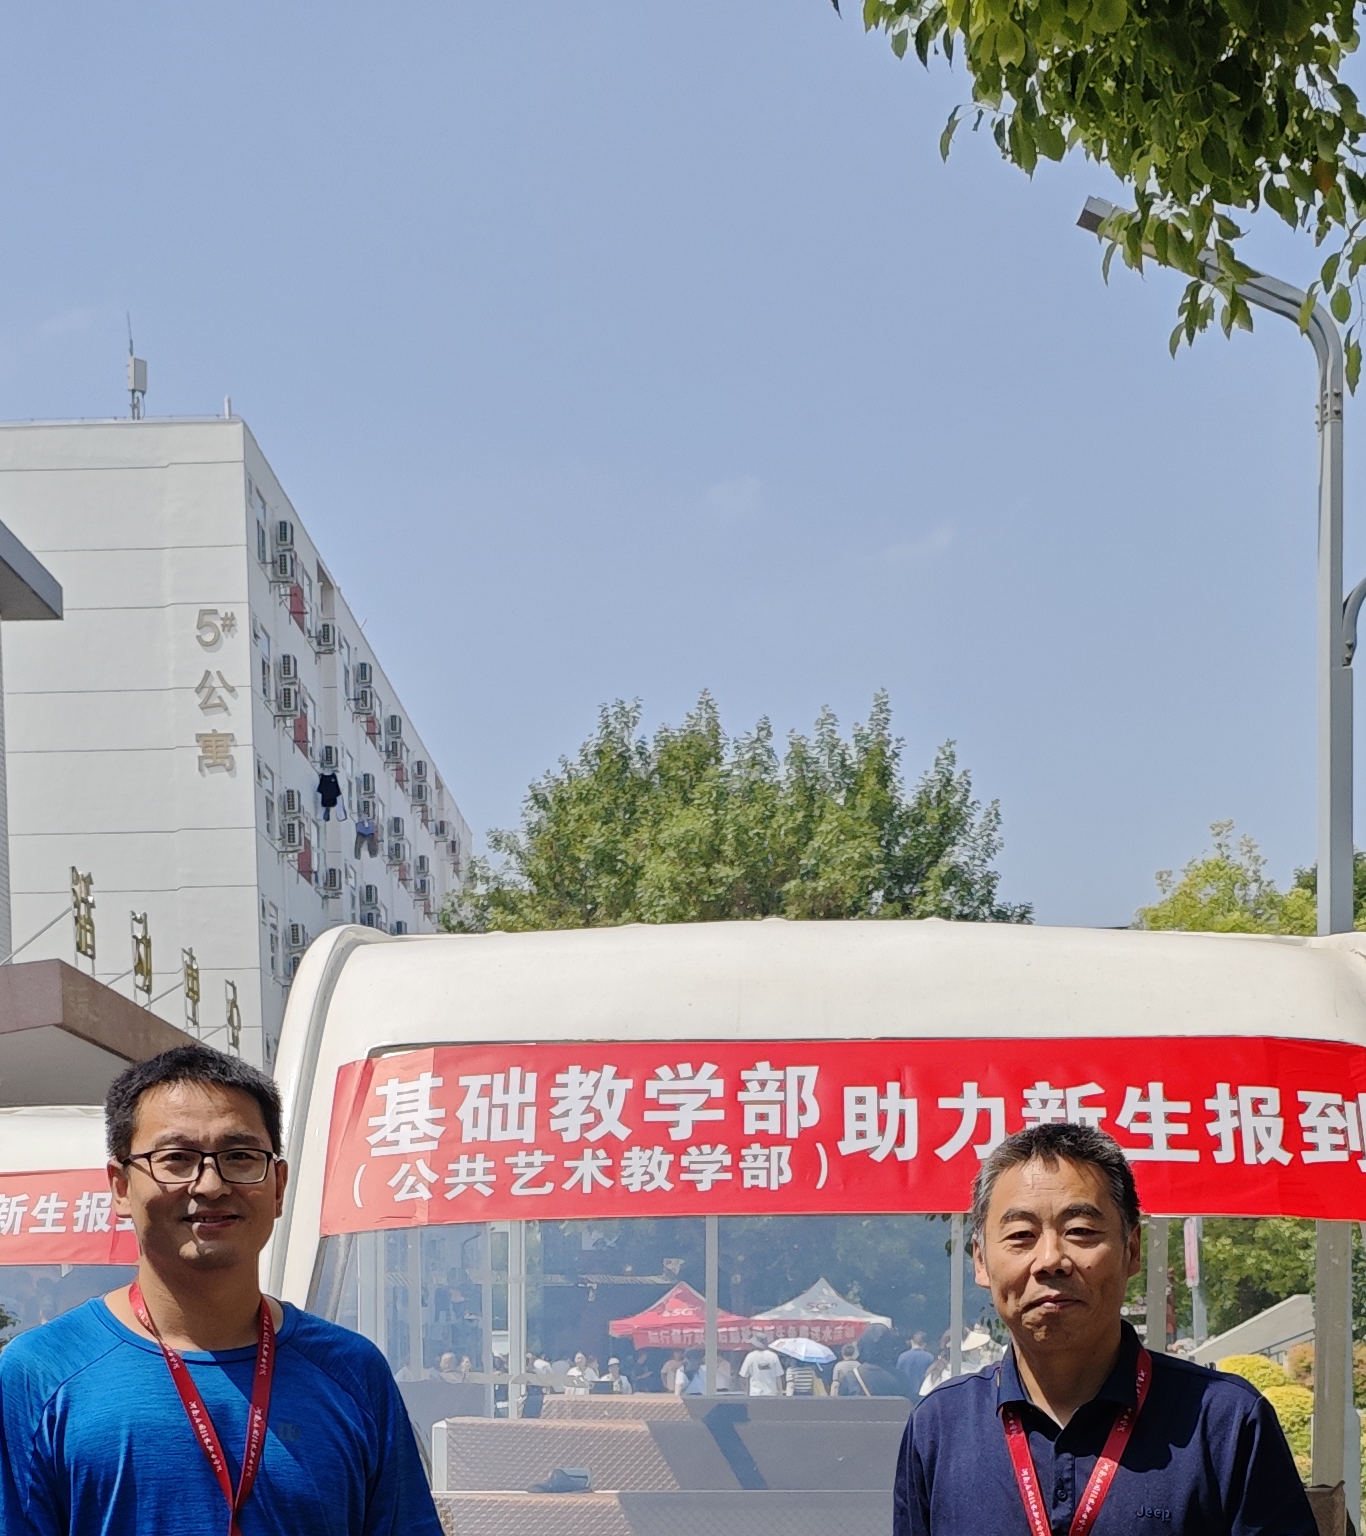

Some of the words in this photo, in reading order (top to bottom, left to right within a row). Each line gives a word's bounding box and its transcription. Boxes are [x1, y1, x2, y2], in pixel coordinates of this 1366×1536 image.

[194, 608, 236, 773] 5#公寓
[366, 1061, 820, 1157] 基础教学部
[1136, 1504, 1172, 1522] Jeep
